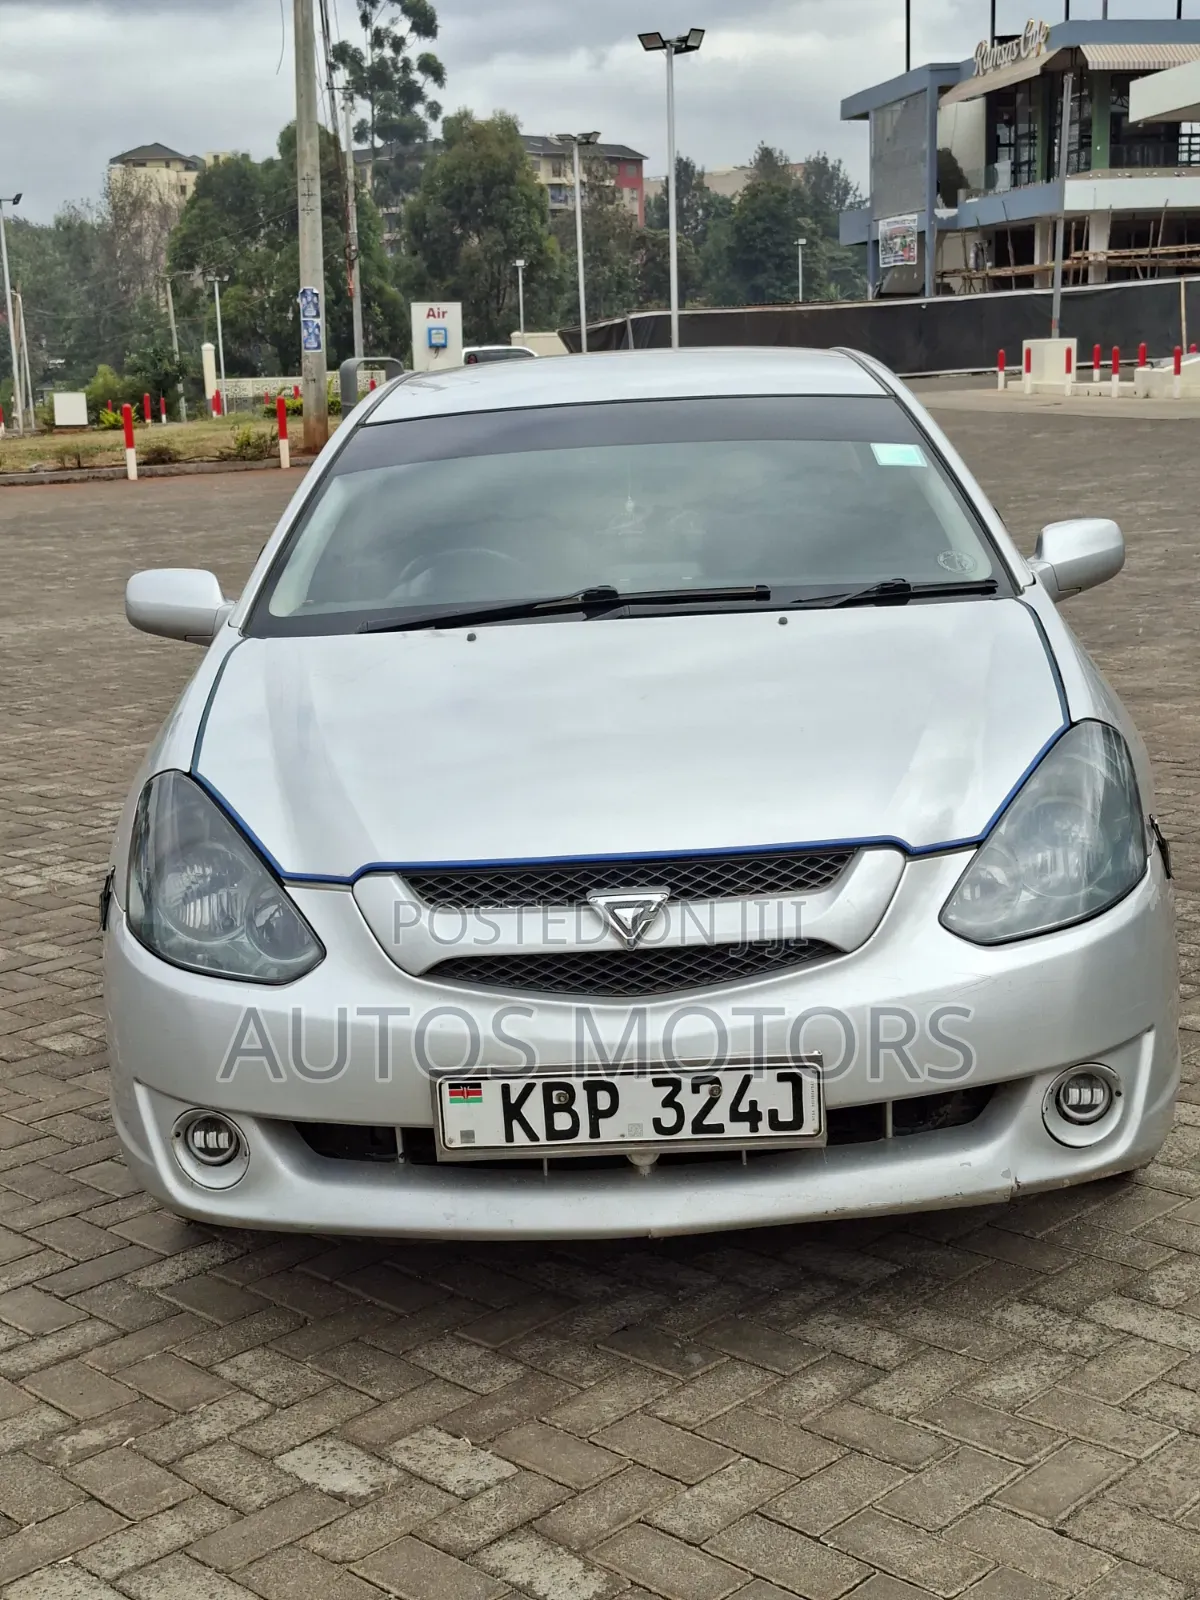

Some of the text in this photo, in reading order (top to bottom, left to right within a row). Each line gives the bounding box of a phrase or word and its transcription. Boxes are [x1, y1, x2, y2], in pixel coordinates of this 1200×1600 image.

[426, 307, 448, 319] Air
[500, 1079, 620, 1143] KBP
[651, 1071, 804, 1136] 324J
